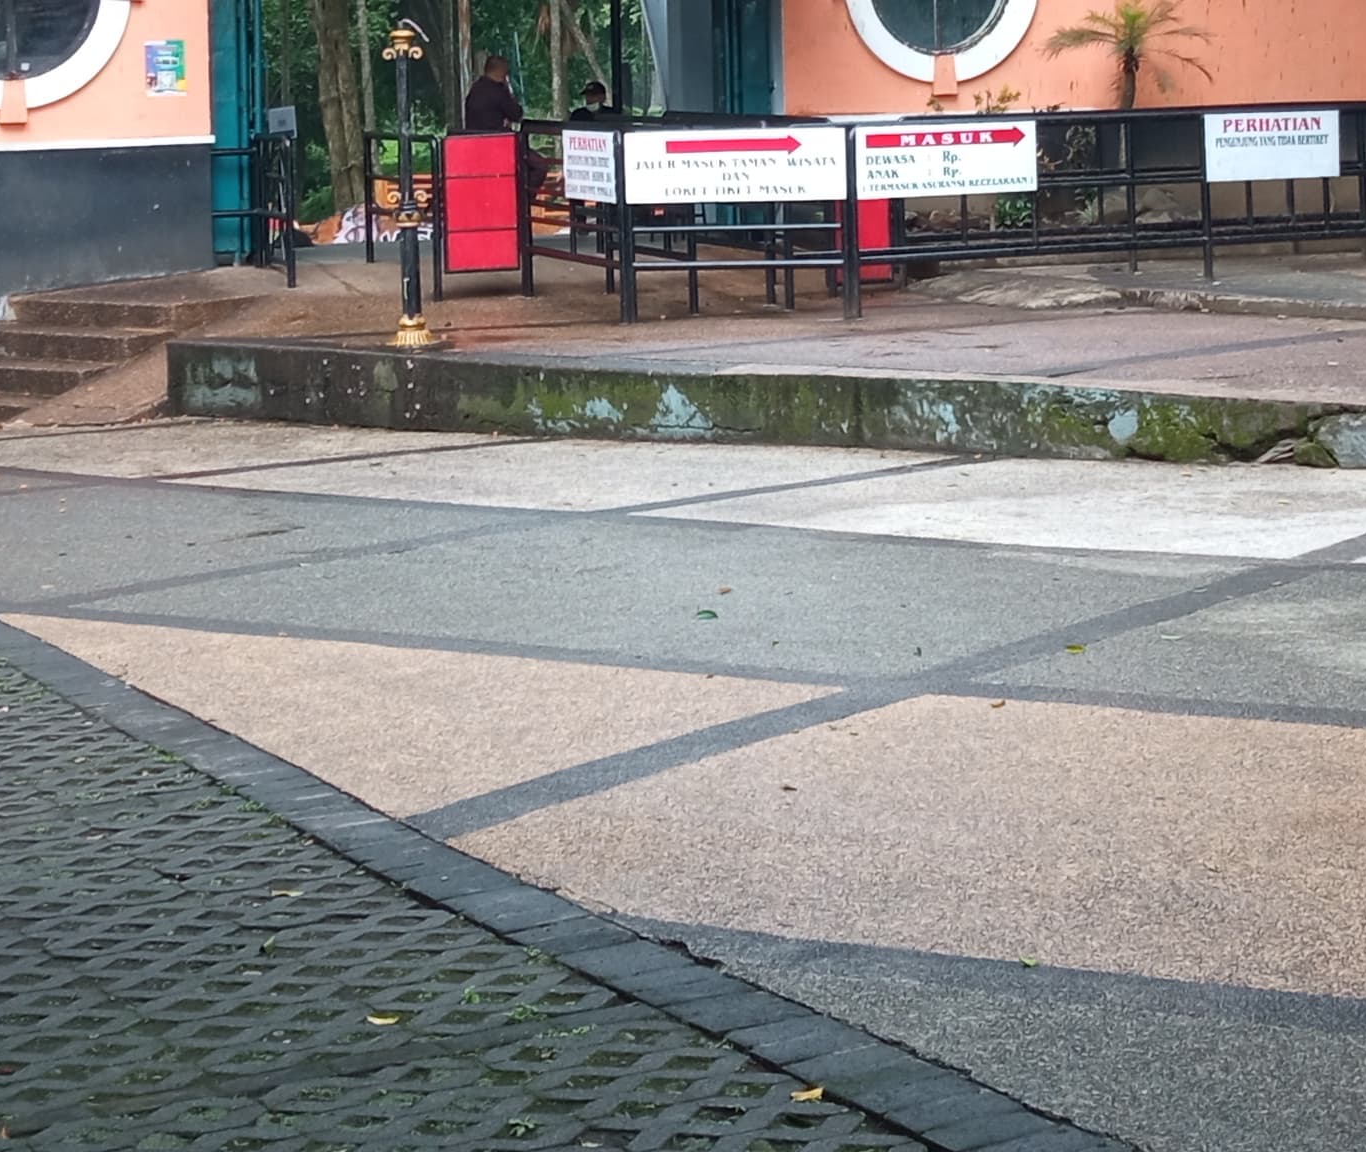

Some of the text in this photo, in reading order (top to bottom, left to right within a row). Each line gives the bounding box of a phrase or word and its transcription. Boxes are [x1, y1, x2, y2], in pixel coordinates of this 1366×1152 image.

[1223, 116, 1321, 133] PERHATIAN
[899, 132, 993, 147] MASUK
[681, 159, 727, 169] MASUK
[732, 158, 776, 167] TAMAN
[787, 157, 836, 167] WISATA
[866, 154, 915, 165] DEWASA
[942, 151, 961, 164] Rp.
[722, 171, 749, 181] DAN
[867, 169, 899, 179] ANAK
[943, 167, 962, 178] Rp.
[759, 185, 806, 195] MASUK
